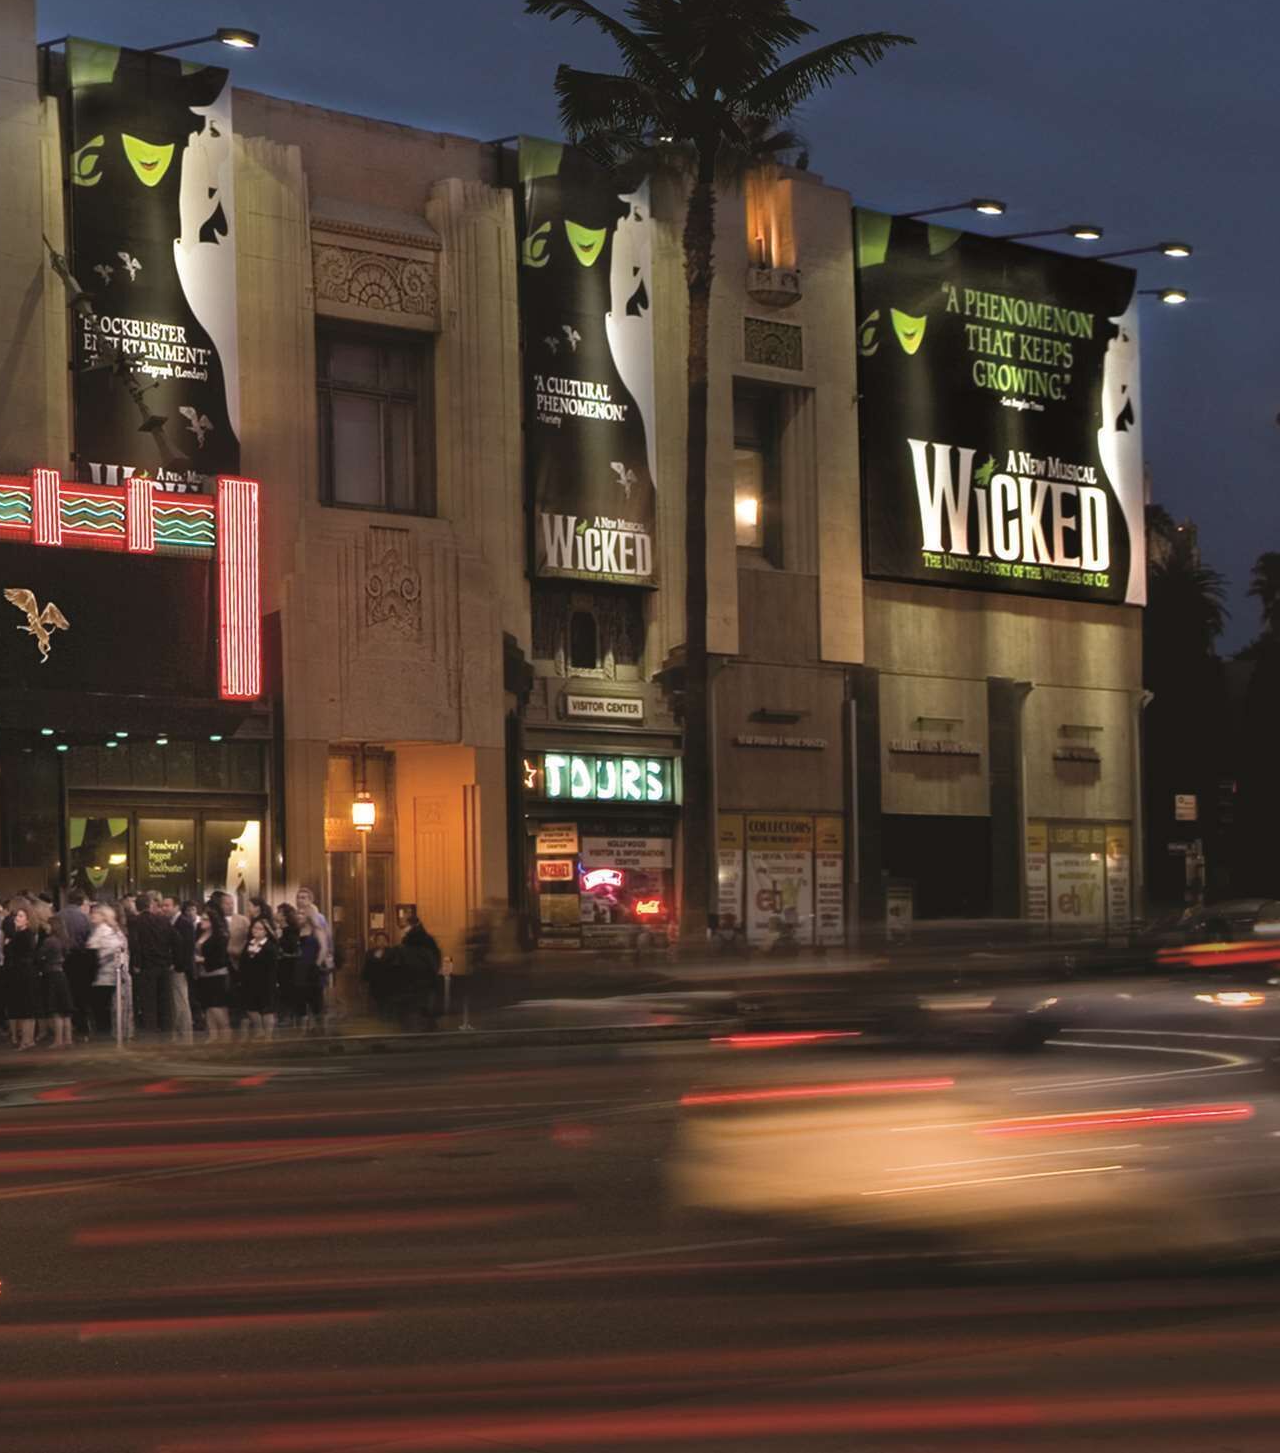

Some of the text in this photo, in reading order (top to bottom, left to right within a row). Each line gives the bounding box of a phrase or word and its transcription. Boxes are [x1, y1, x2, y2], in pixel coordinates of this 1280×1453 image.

[963, 288, 1095, 341] PHENOMENON
[964, 323, 1074, 369] THAT KEEPS
[546, 376, 611, 402] CULTURAL
[972, 359, 1072, 400] GROWING.”
[536, 394, 628, 421] PHENOMENON.”
[1006, 450, 1097, 485] A NEW MUSICAL
[593, 516, 601, 529] A
[571, 701, 640, 714] VISITOR CENTER
[545, 754, 663, 800] TOURS
